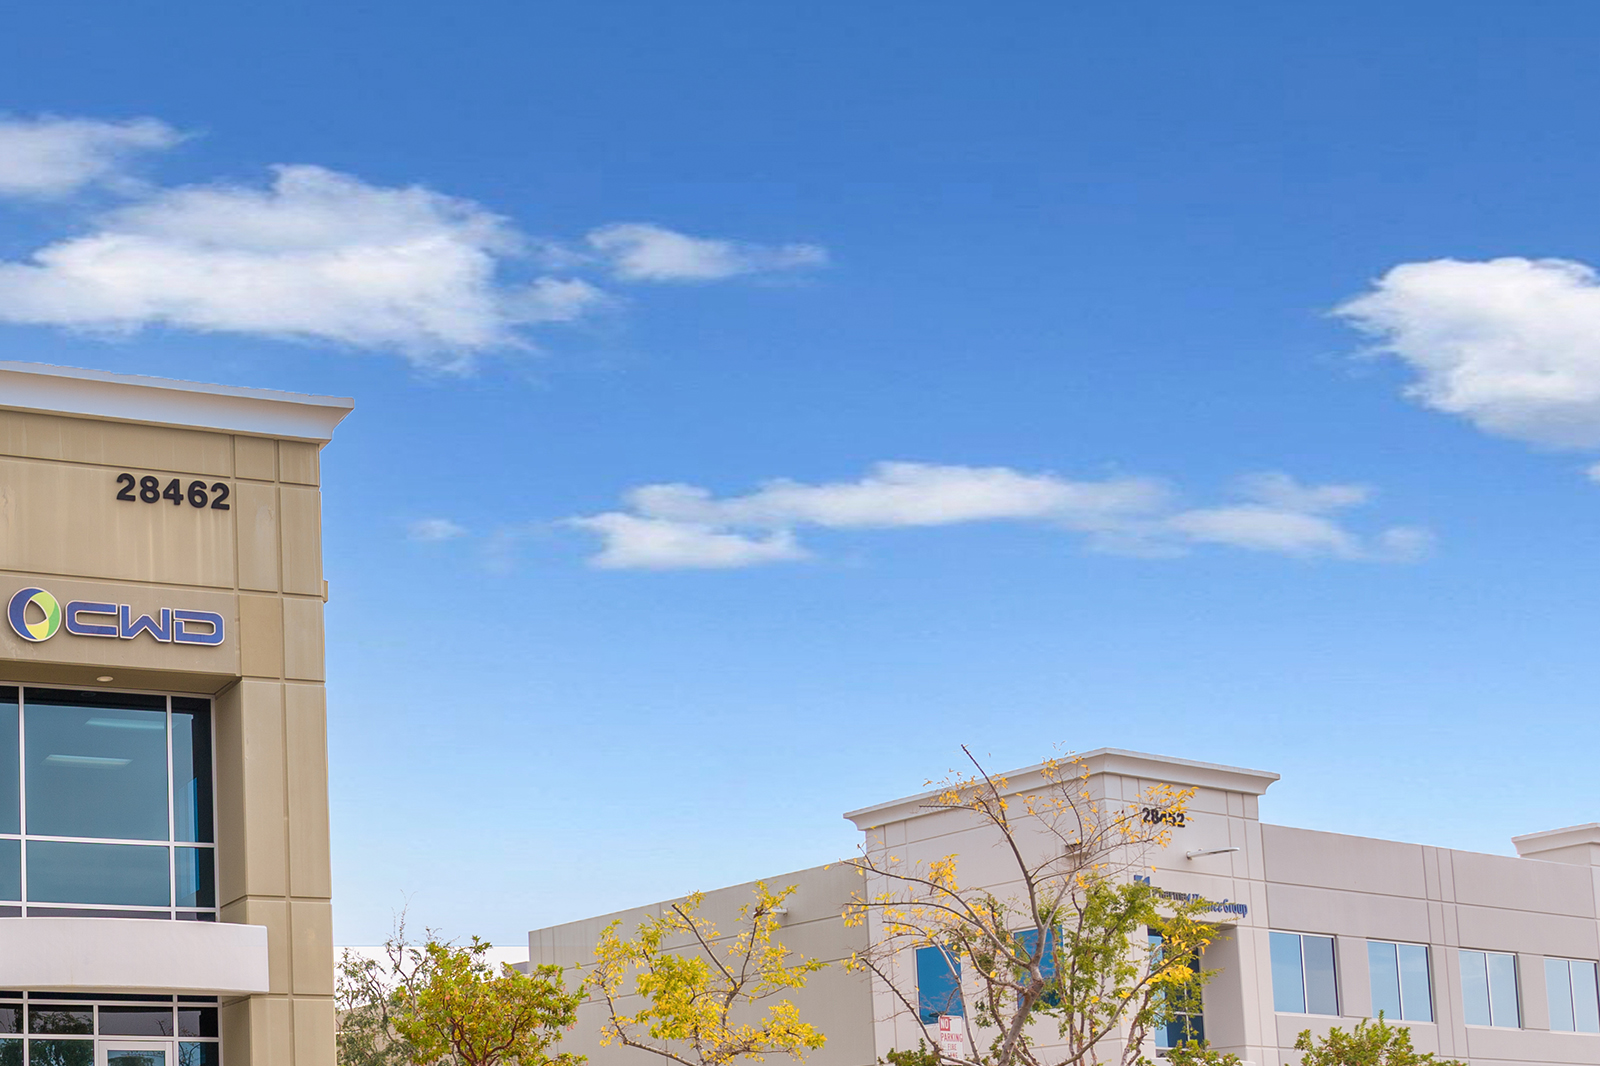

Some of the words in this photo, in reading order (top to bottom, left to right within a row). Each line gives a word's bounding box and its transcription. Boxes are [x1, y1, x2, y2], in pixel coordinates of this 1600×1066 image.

[116, 473, 230, 510] 28462
[65, 600, 225, 646] CWD
[1223, 898, 1248, 918] Group
[940, 1018, 949, 1029] NO
[940, 1033, 963, 1042] PARKING
